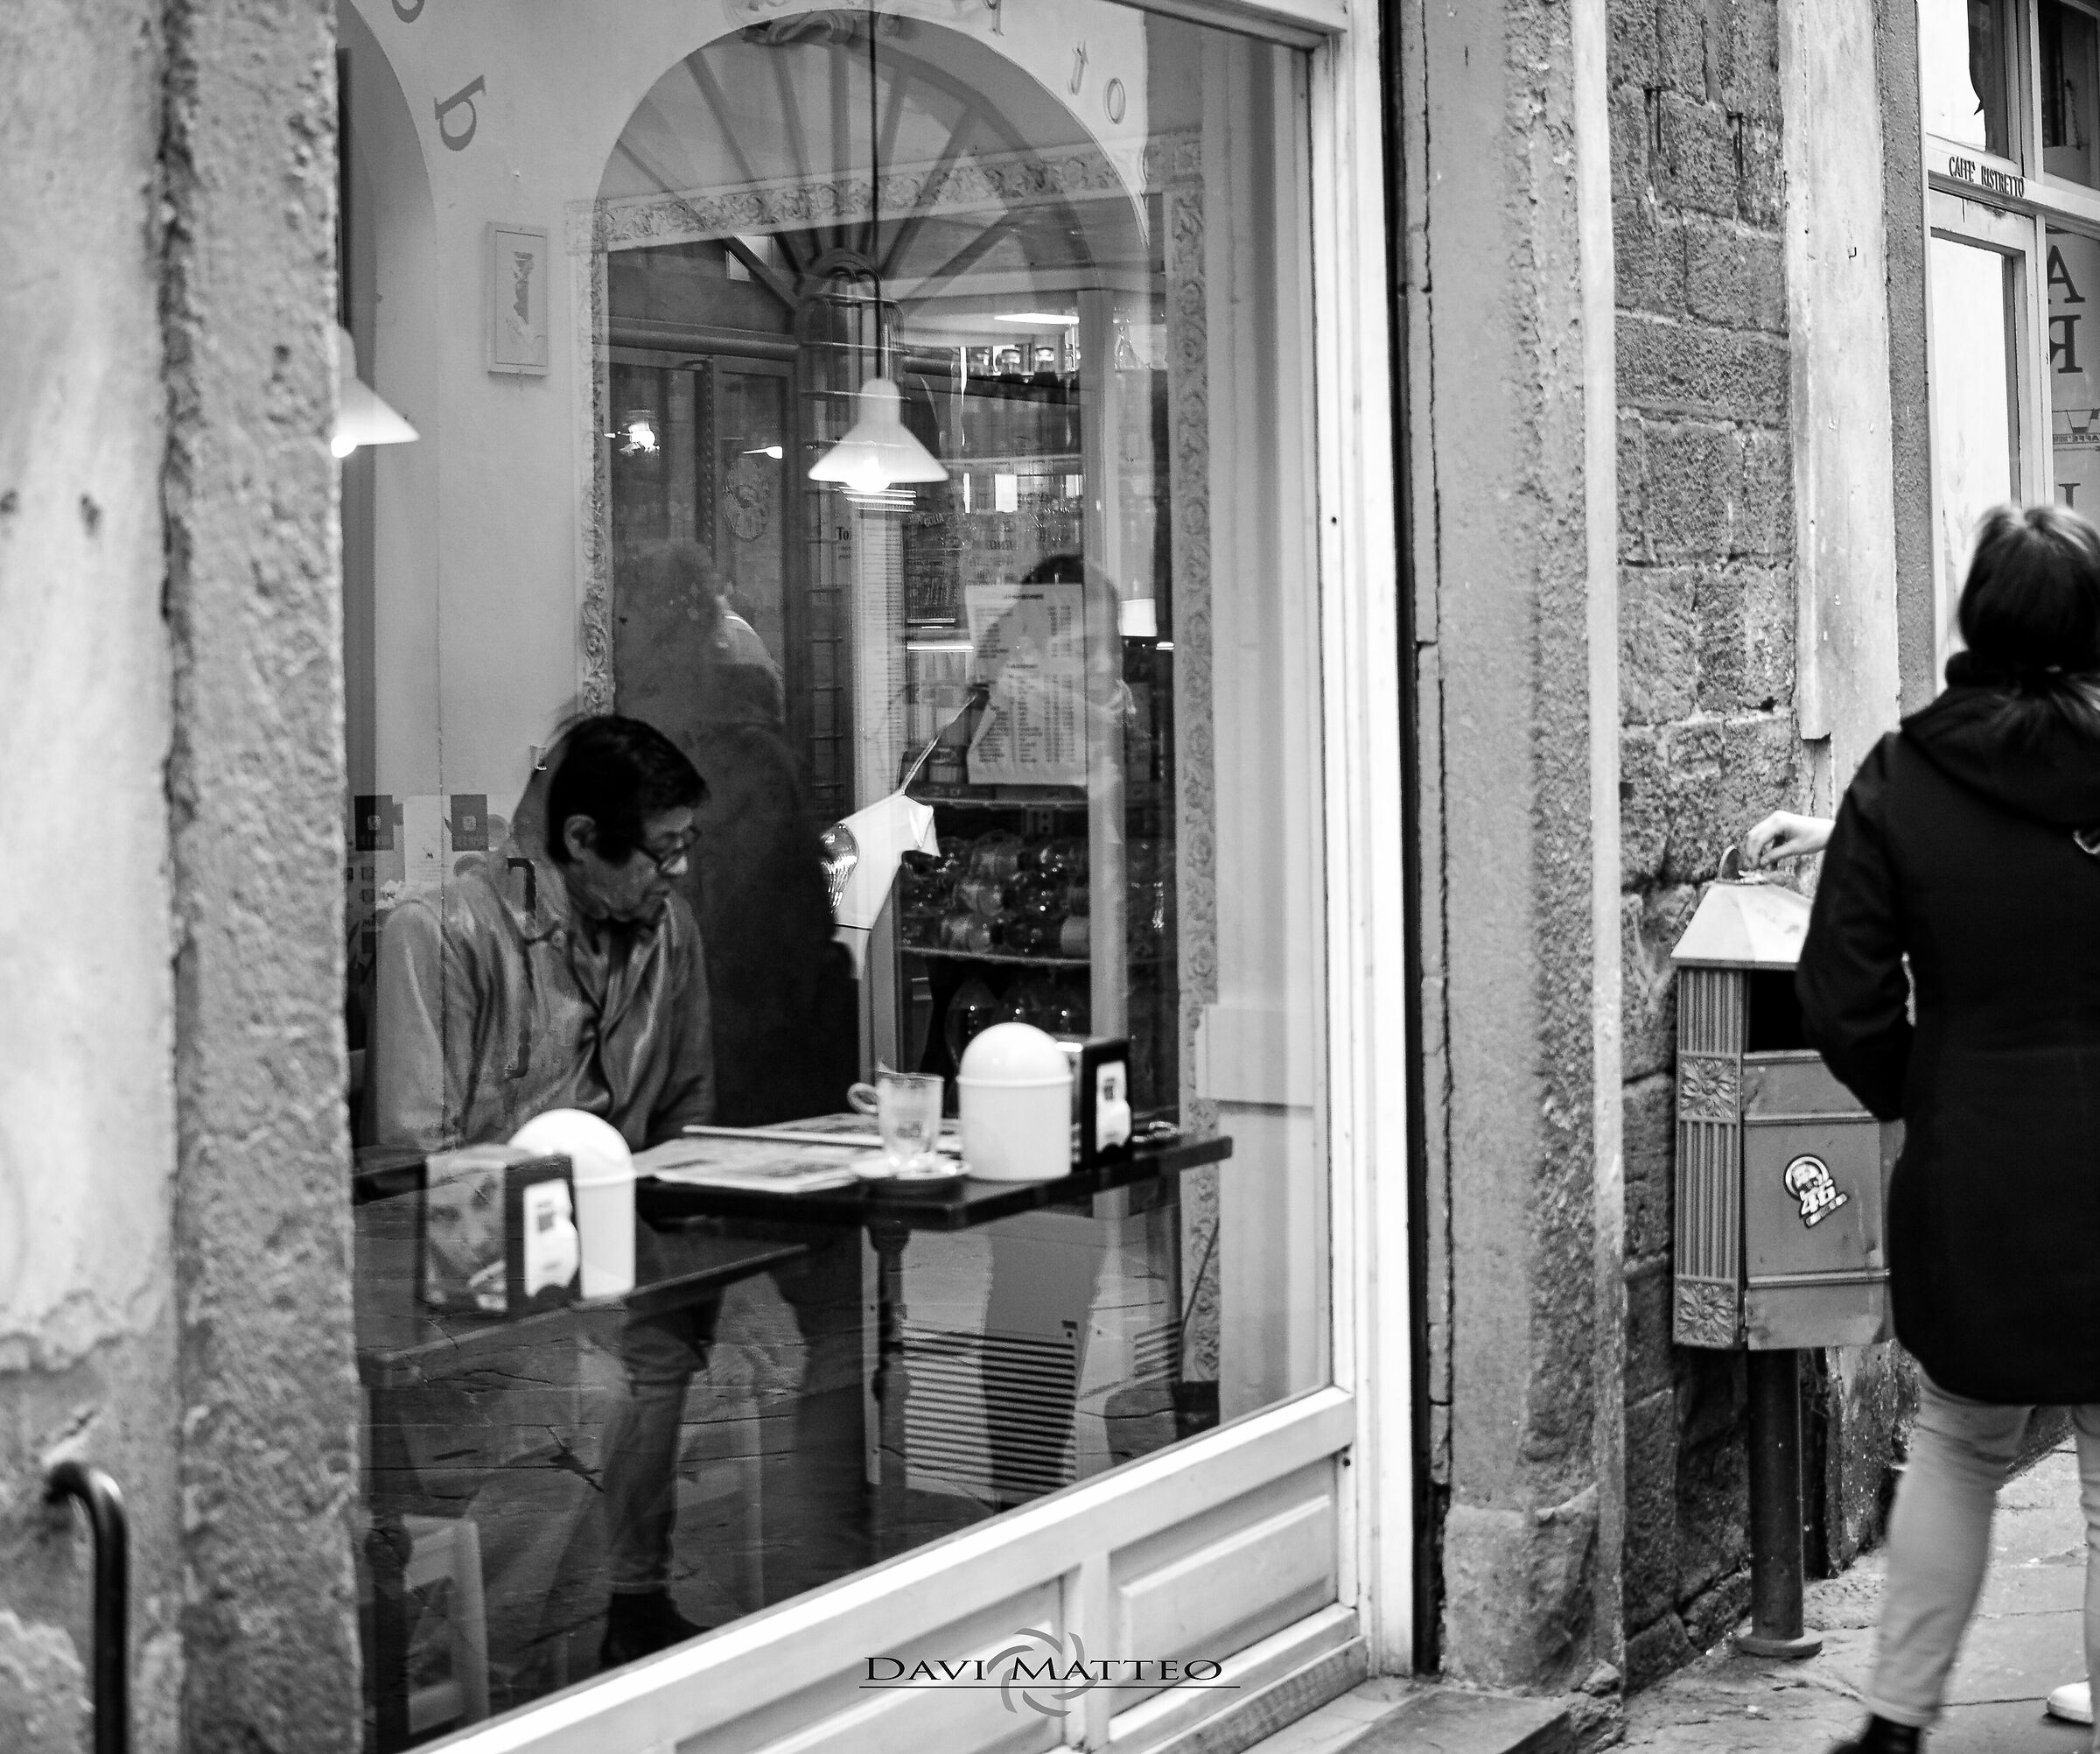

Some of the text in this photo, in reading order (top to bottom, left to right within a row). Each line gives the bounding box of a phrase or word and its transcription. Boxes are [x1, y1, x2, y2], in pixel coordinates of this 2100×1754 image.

[1949, 156, 2024, 198] CAFFE' RISTRETTO
[1800, 1178, 1837, 1216] 46
